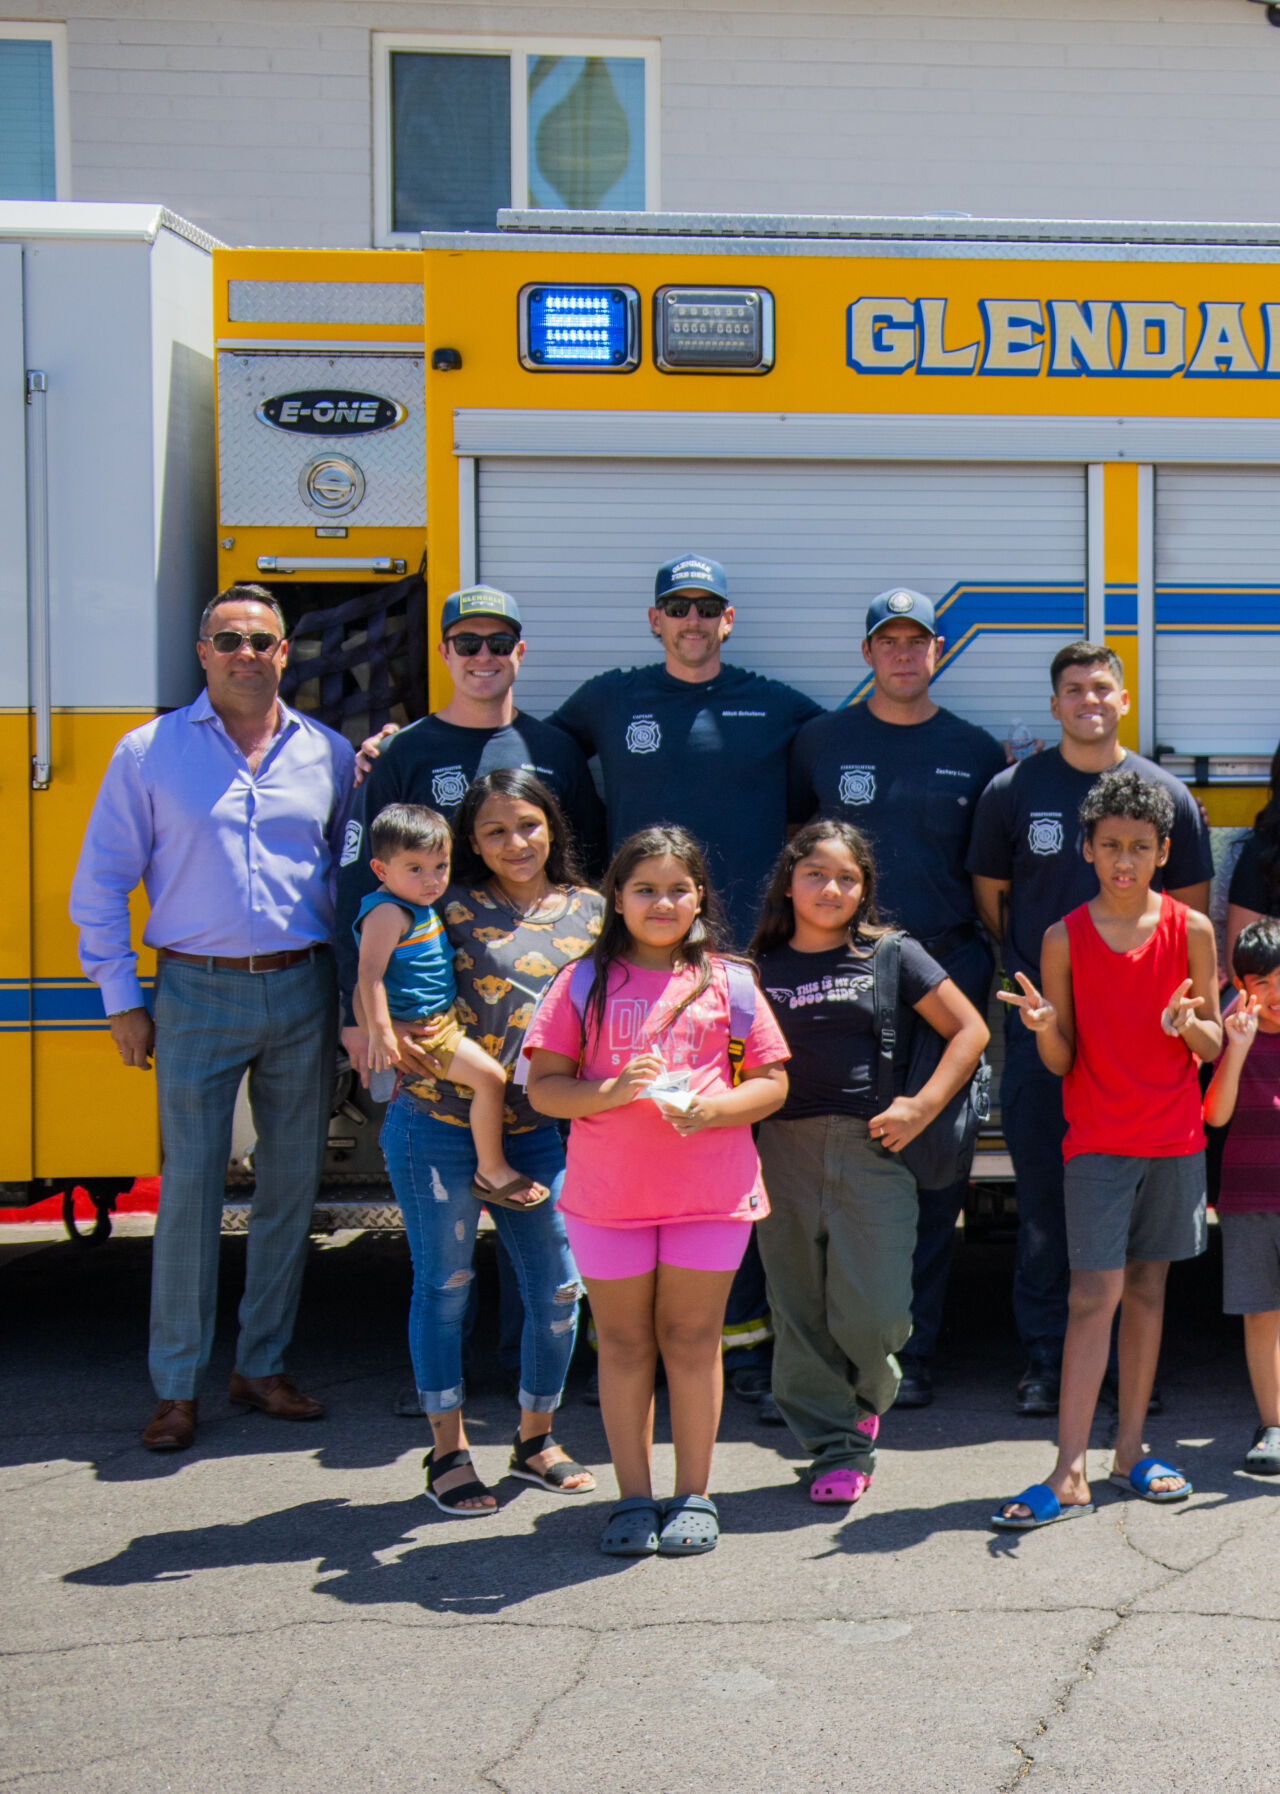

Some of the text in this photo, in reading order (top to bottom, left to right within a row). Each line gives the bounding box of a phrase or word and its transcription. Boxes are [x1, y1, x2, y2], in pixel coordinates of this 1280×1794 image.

[278, 401, 380, 423] E-ONE
[796, 977, 849, 996] THIS IS MY
[789, 987, 858, 1009] GOOD SIDE
